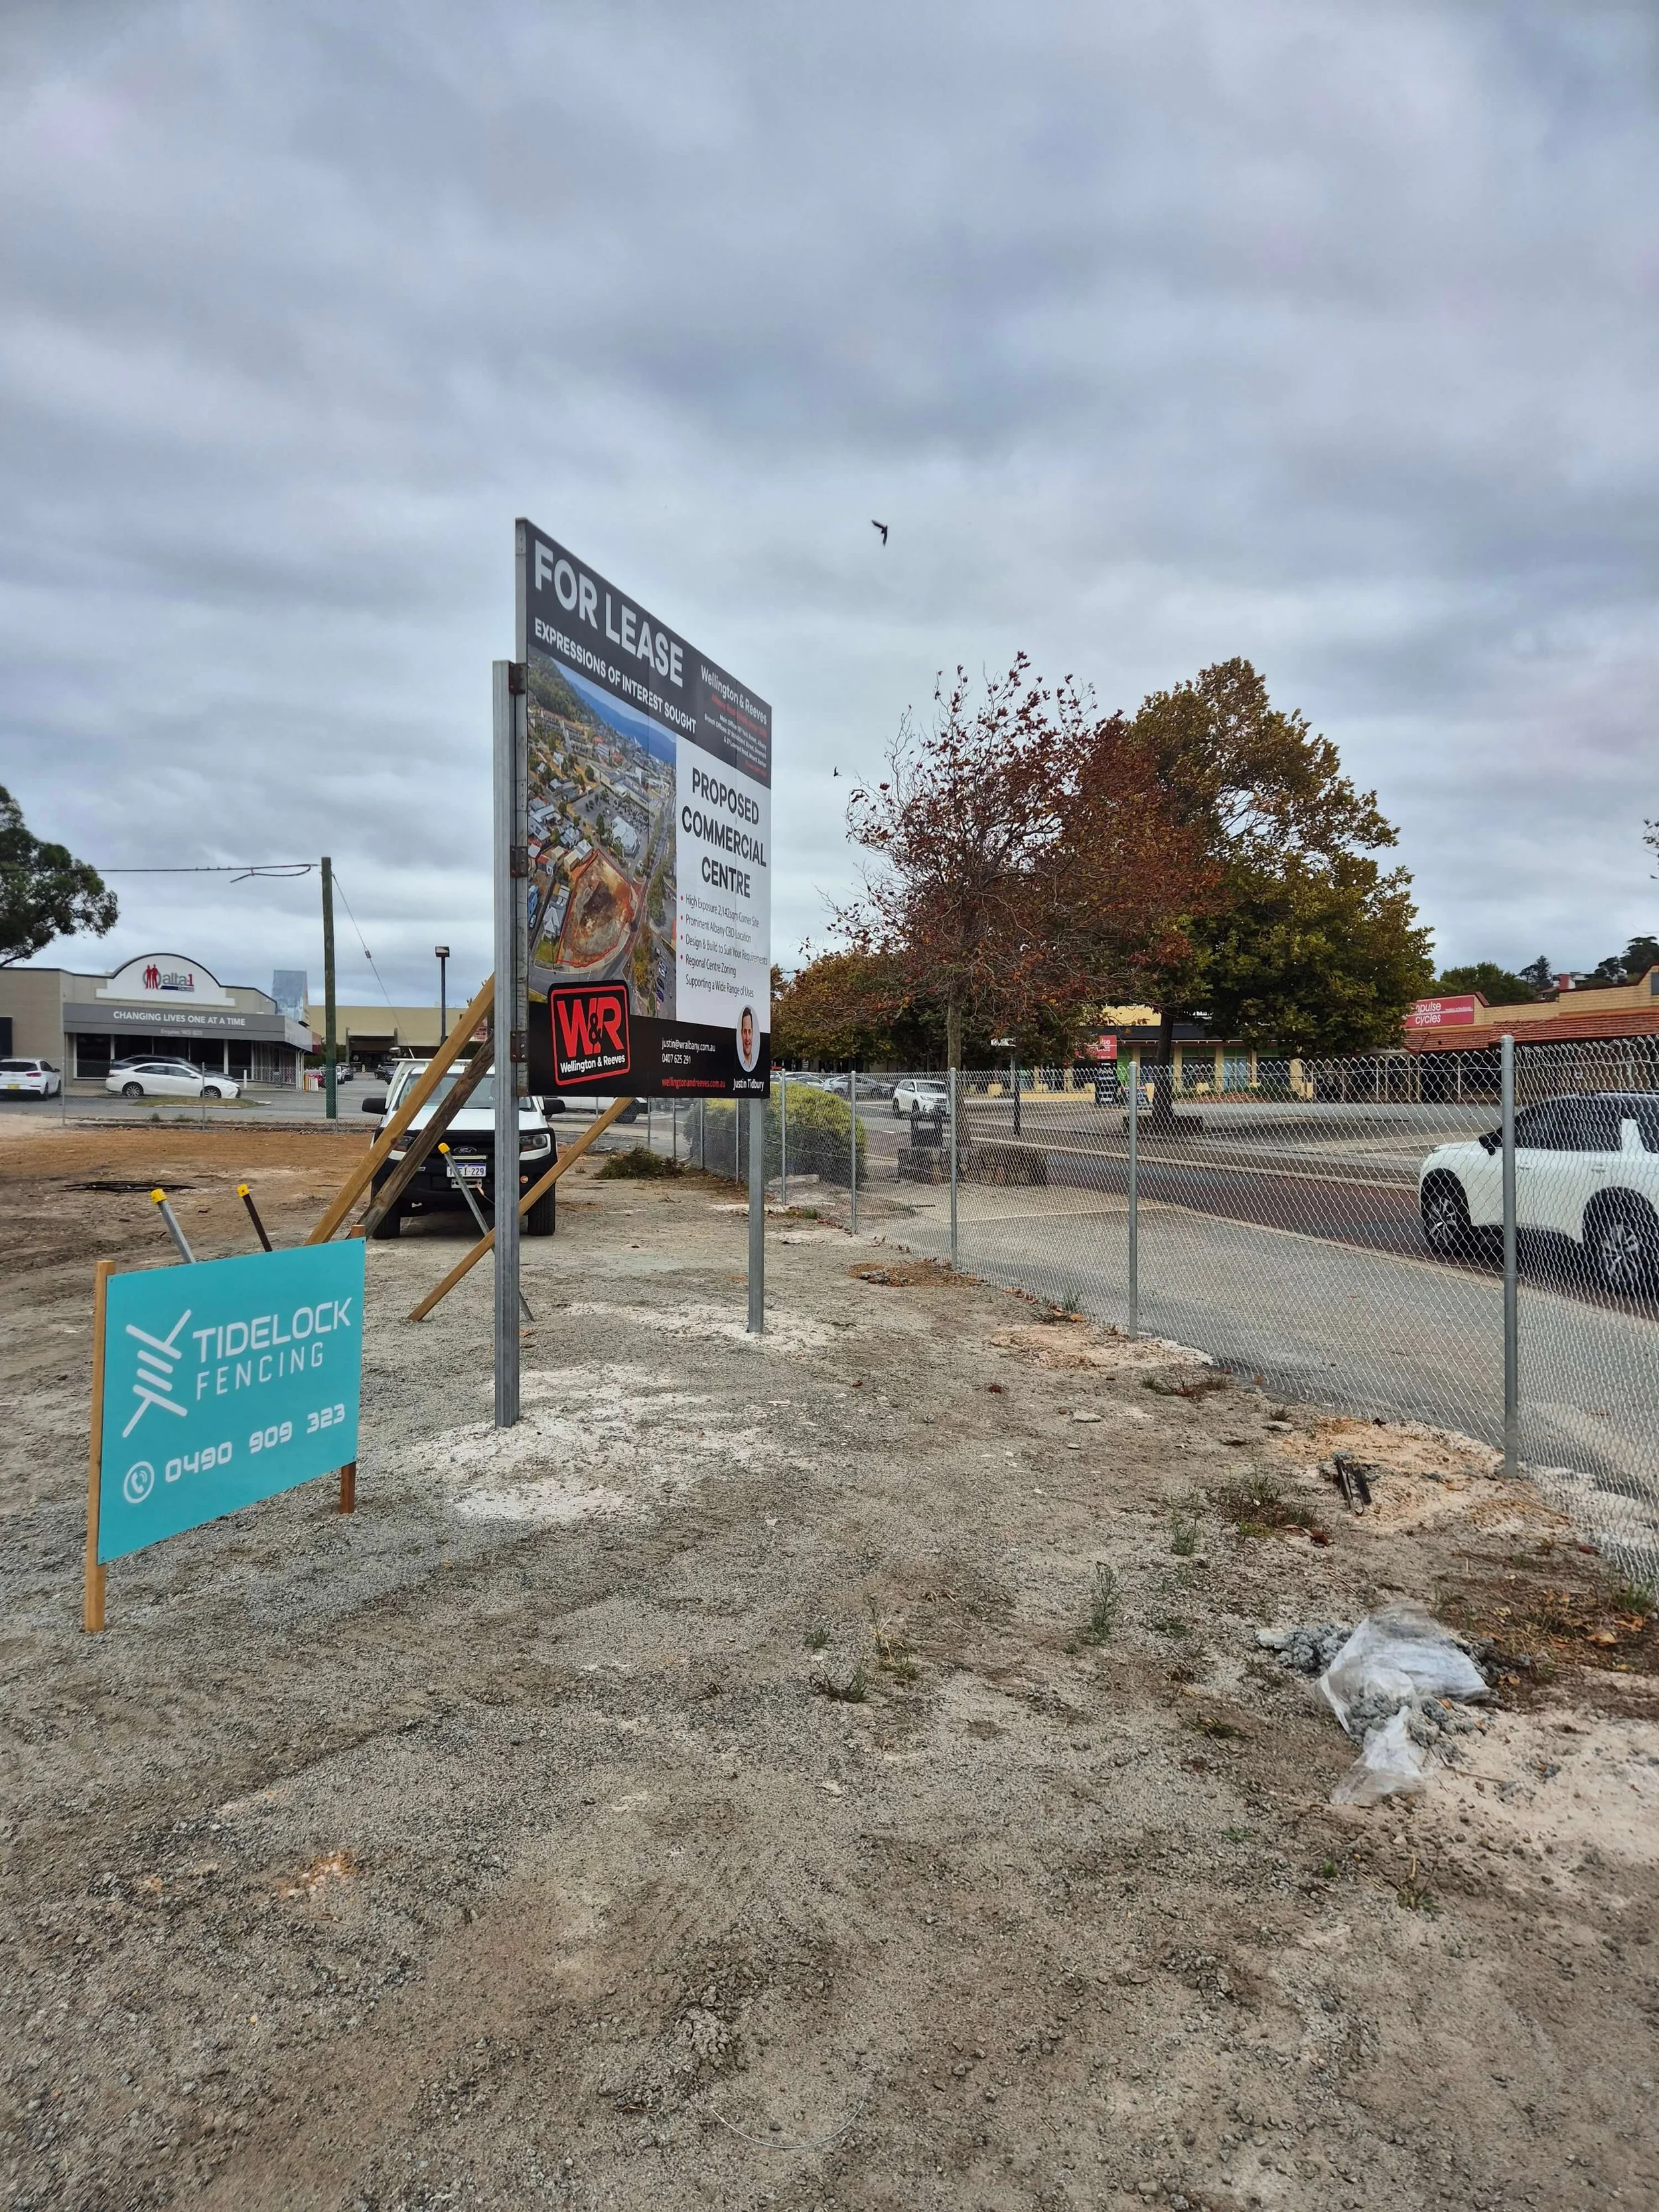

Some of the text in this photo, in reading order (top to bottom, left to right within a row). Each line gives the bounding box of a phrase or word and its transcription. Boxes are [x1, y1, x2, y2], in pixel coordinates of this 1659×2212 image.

[535, 539, 684, 688] FOR LEASE
[535, 617, 607, 679] EXPRESSIONS
[608, 666, 621, 686] OF
[622, 674, 663, 713] INTEREST
[664, 701, 697, 733] SOUGHT
[701, 665, 739, 704] Wellington
[739, 694, 745, 708] &
[745, 698, 767, 725] Reeves
[705, 713, 715, 725] Branch
[692, 767, 759, 825] PROPOSED
[682, 805, 766, 867] COMMERCIAL
[701, 856, 751, 899] CENTRE
[686, 894, 697, 909] High
[698, 898, 717, 913] Exposure
[718, 905, 739, 921] 2,142sqm
[739, 913, 752, 925] Corner
[686, 914, 752, 943] Prominent Albany CBD Location
[686, 934, 701, 950] Design
[702, 939, 706, 949] &
[707, 940, 718, 952] Build
[719, 944, 723, 954] to
[732, 947, 742, 958] Your
[742, 950, 768, 966] Requirements
[686, 954, 736, 978] Regional Centre Zoning
[686, 974, 711, 992] Supporting
[715, 980, 727, 992] Wide
[727, 983, 740, 995] Range
[740, 986, 744, 995] of
[745, 986, 754, 997] Uses
[113, 1011, 161, 1021] CHANGING
[163, 1014, 186, 1023] LIVES
[187, 1015, 206, 1024] ONE
[226, 1017, 246, 1026] TIME
[1415, 1001, 1441, 1013] pulse
[1415, 1013, 1441, 1027] cycles
[557, 996, 624, 1058] W&R
[662, 1038, 716, 1053] justin@wralbany.com.au
[662, 1053, 691, 1065] 0407 625 291
[560, 1055, 626, 1074] Wellington & Reeves
[662, 1076, 726, 1089] wellingtonandreeves.com.au
[733, 1078, 764, 1091] Justin Tidbury
[192, 1297, 352, 1363] TIDELOCK
[196, 1341, 324, 1402] FENCING
[165, 1403, 346, 1483] 0490 909 323
